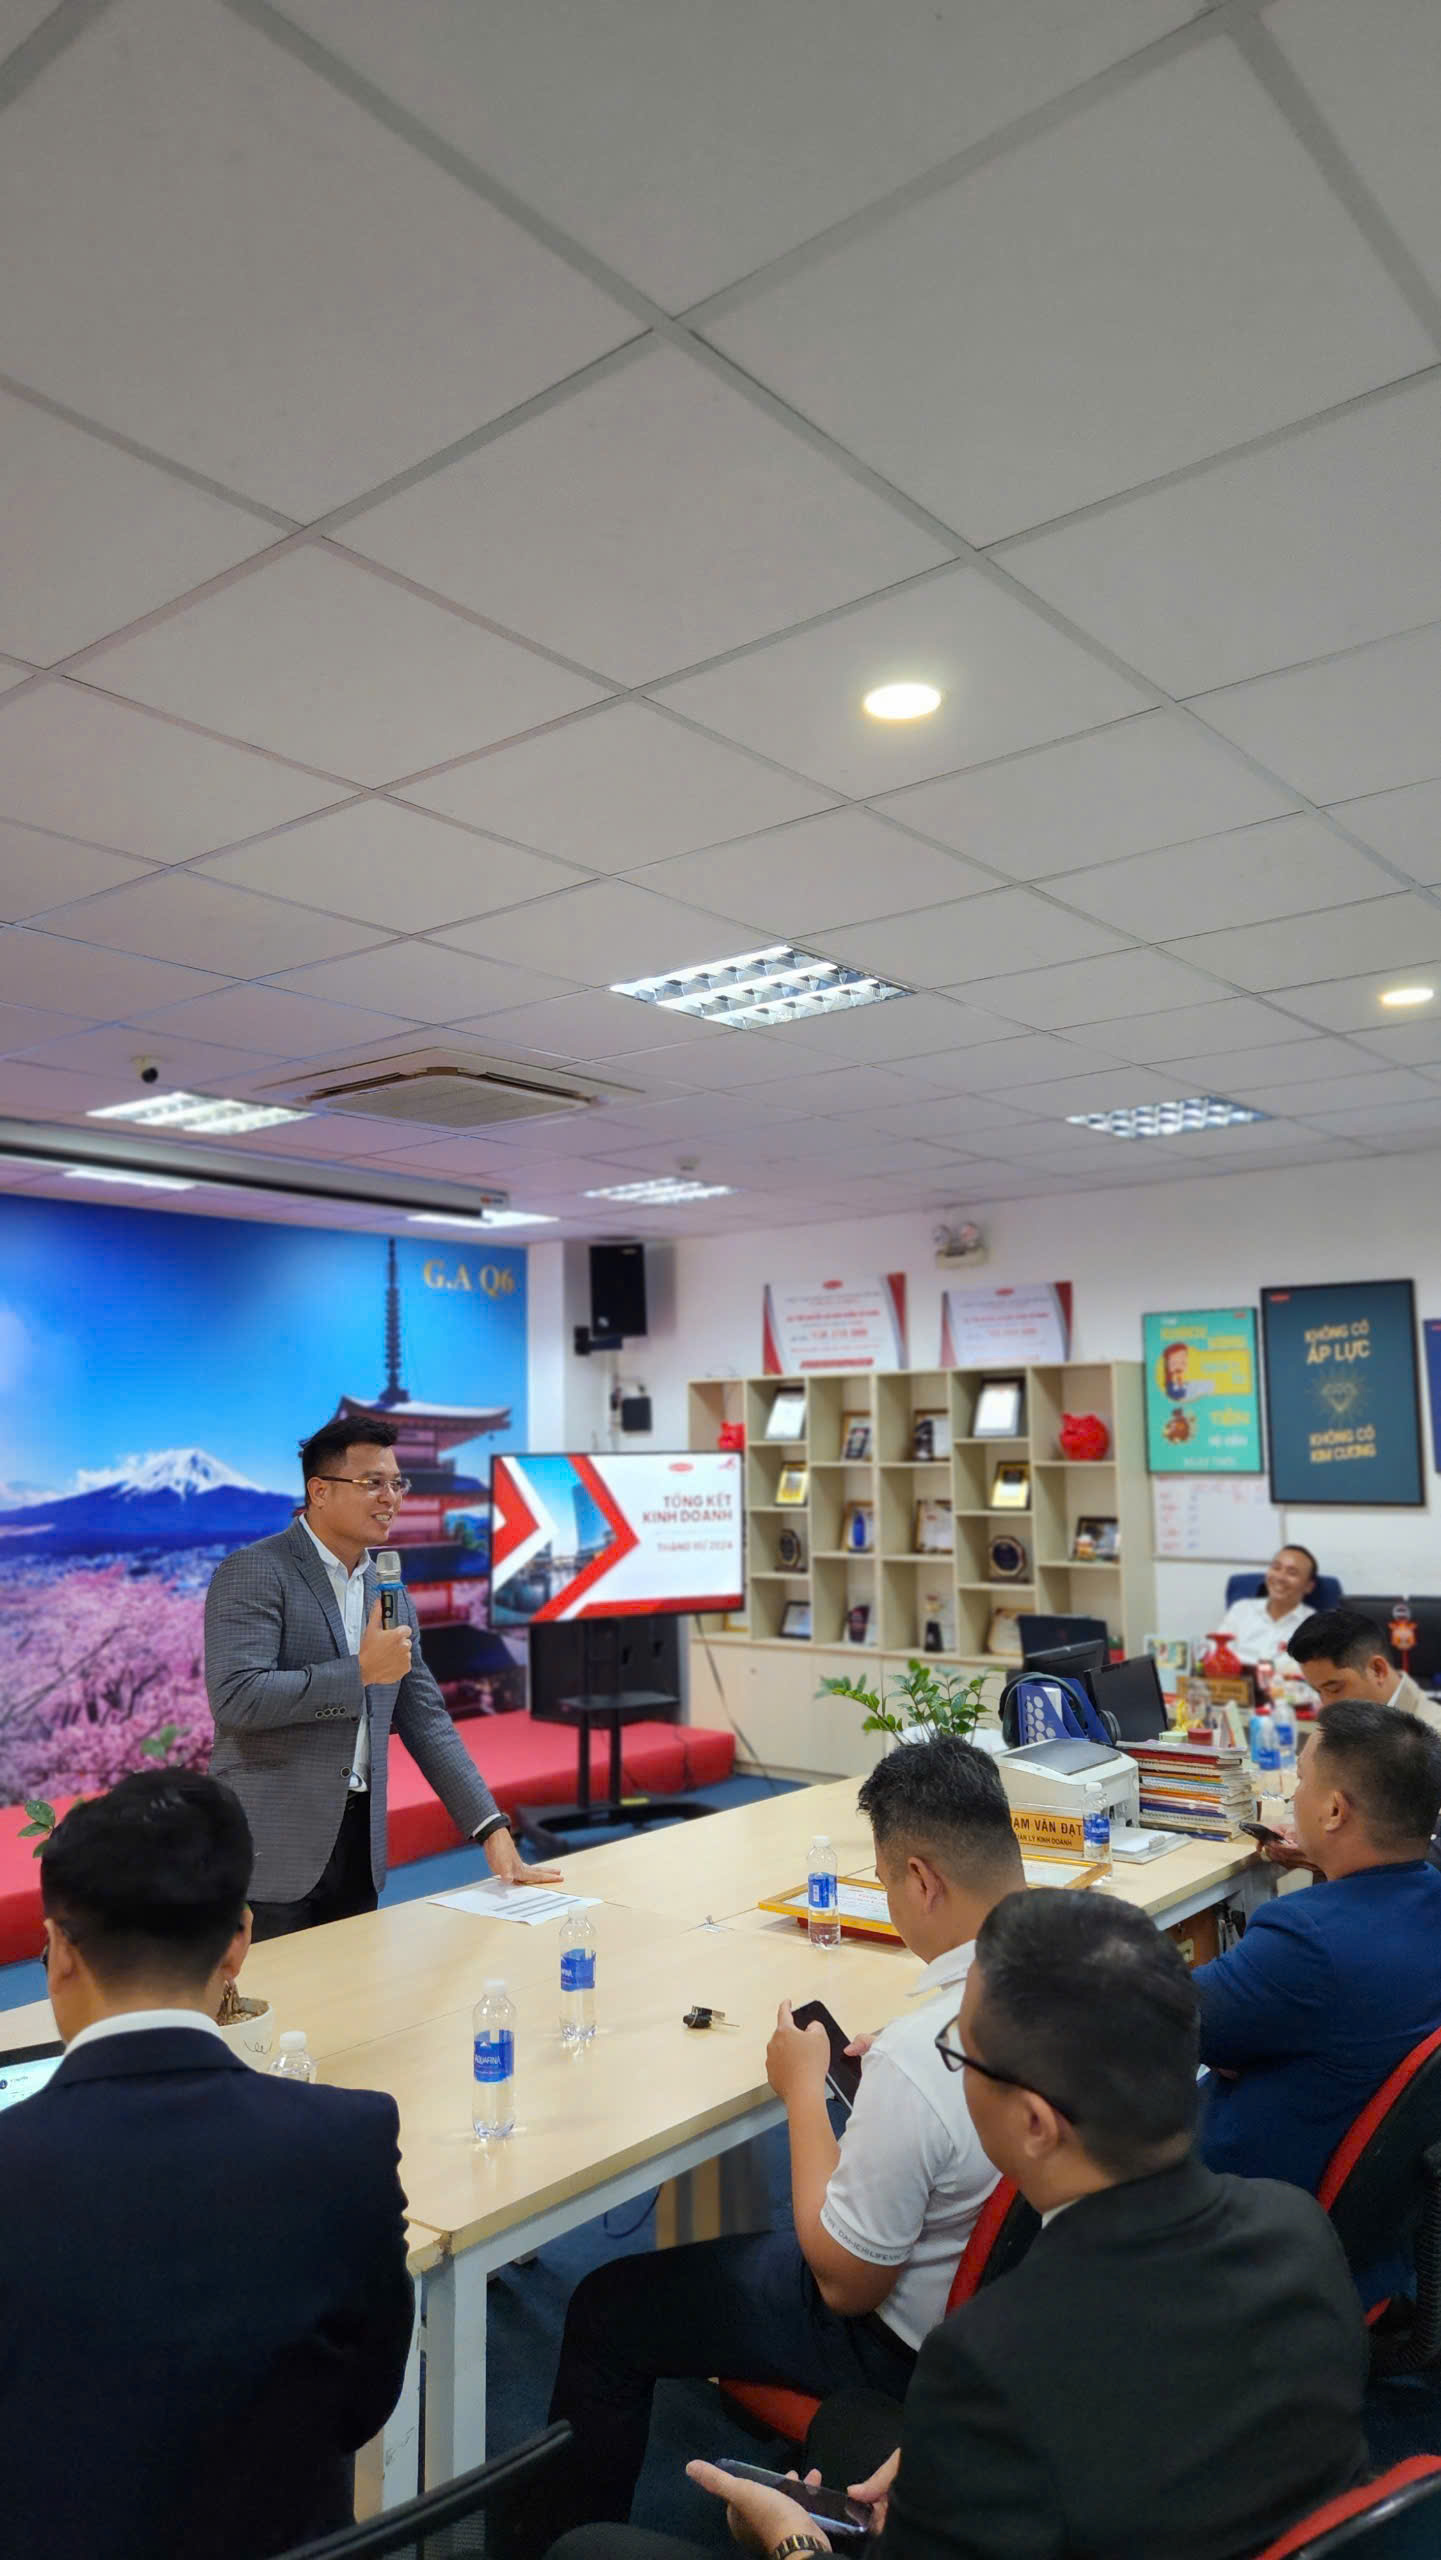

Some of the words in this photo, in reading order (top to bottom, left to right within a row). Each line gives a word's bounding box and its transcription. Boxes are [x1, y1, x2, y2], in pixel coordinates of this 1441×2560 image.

[423, 1259, 472, 1291] G.A
[480, 1264, 515, 1297] Q6
[1304, 1324, 1349, 1343] KHÔNG
[1352, 1317, 1369, 1336] CÓ
[1306, 1342, 1332, 1364] ÁP
[1334, 1338, 1370, 1364] LỰC
[1309, 1428, 1352, 1447] KHÔNG
[1356, 1424, 1376, 1441] CÓ
[1309, 1447, 1333, 1463] KIM
[663, 1491, 703, 1508] TỔNG
[706, 1490, 731, 1507] KẾT
[642, 1511, 677, 1522] KINH
[680, 1509, 732, 1521] DOANH
[1010, 1817, 1030, 1831] ẠM
[1034, 1818, 1057, 1833] VĂN
[1061, 1822, 1083, 1838] ĐẠT
[1037, 1836, 1051, 1844] KINH
[1052, 1838, 1072, 1847] DOANH
